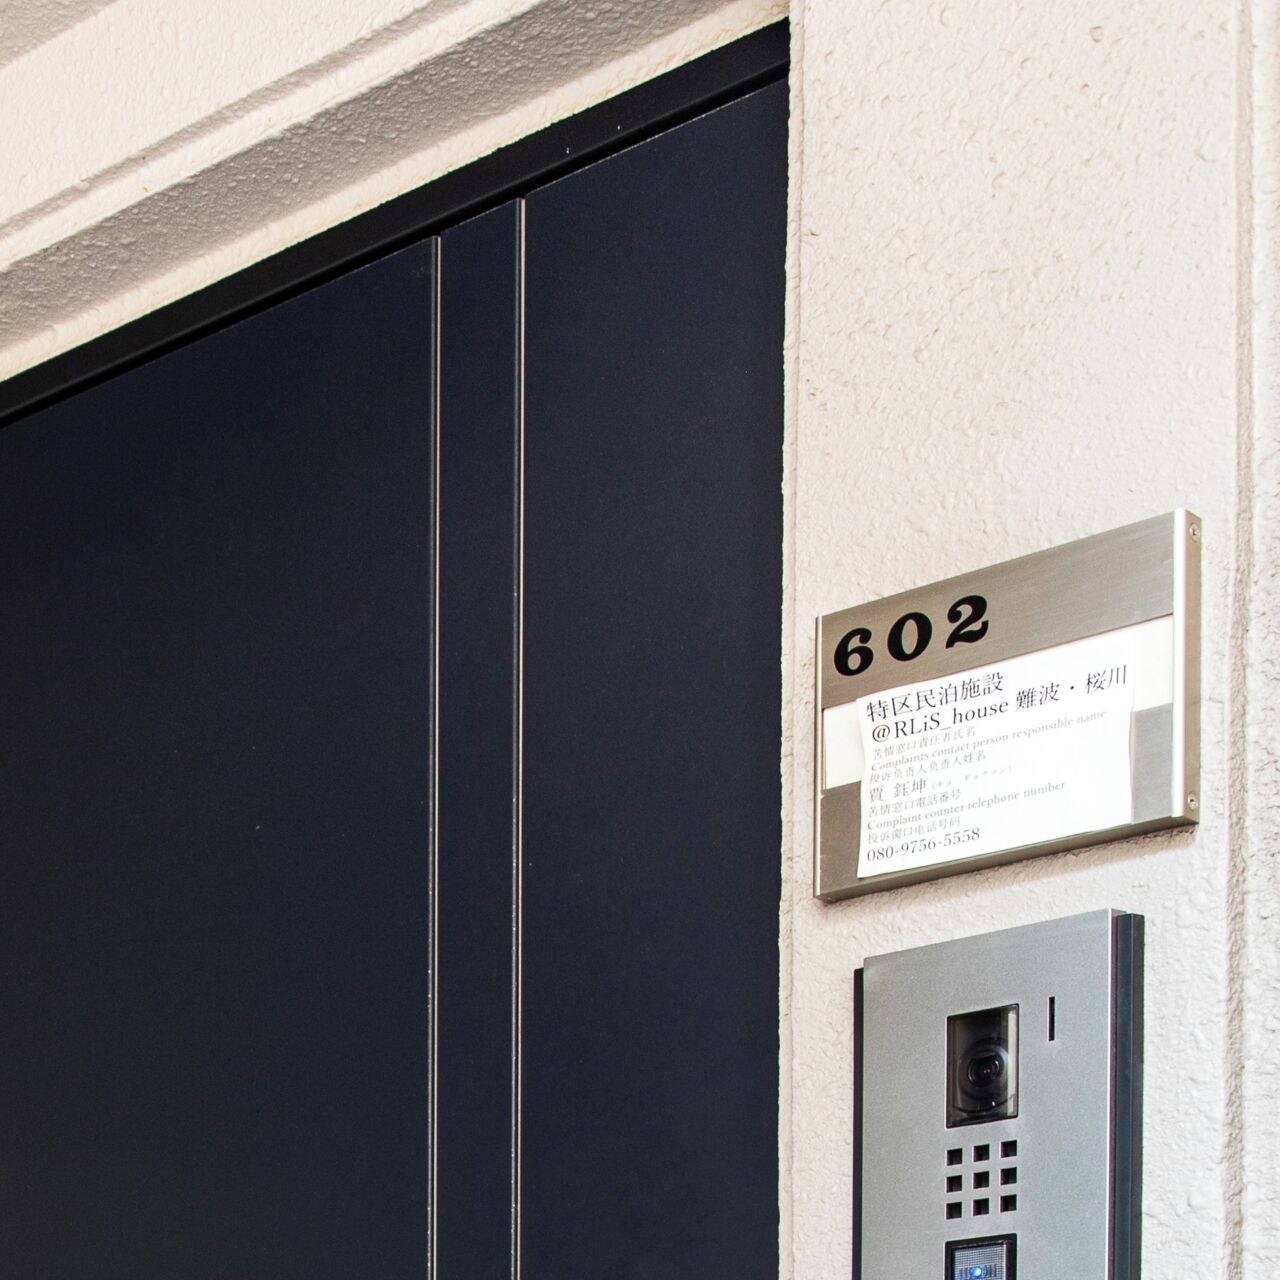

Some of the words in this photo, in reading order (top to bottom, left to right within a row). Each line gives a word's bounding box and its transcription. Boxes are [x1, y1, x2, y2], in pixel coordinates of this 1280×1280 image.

[833, 594, 990, 677] 602
[866, 671, 1004, 723] 特区民泊施設
[871, 700, 1009, 744] @RLiS_house
[1015, 664, 1128, 711] 難波・桜川
[871, 750, 930, 773] Complaints
[931, 742, 971, 759] contact
[972, 734, 1009, 753] person
[1011, 716, 1074, 740] responsible
[1076, 710, 1107, 724] name
[867, 810, 922, 832] Complaint
[924, 803, 965, 821] counter
[967, 789, 1021, 812] telephone
[1023, 780, 1066, 798] number
[866, 827, 981, 862] 080-9756-5558
